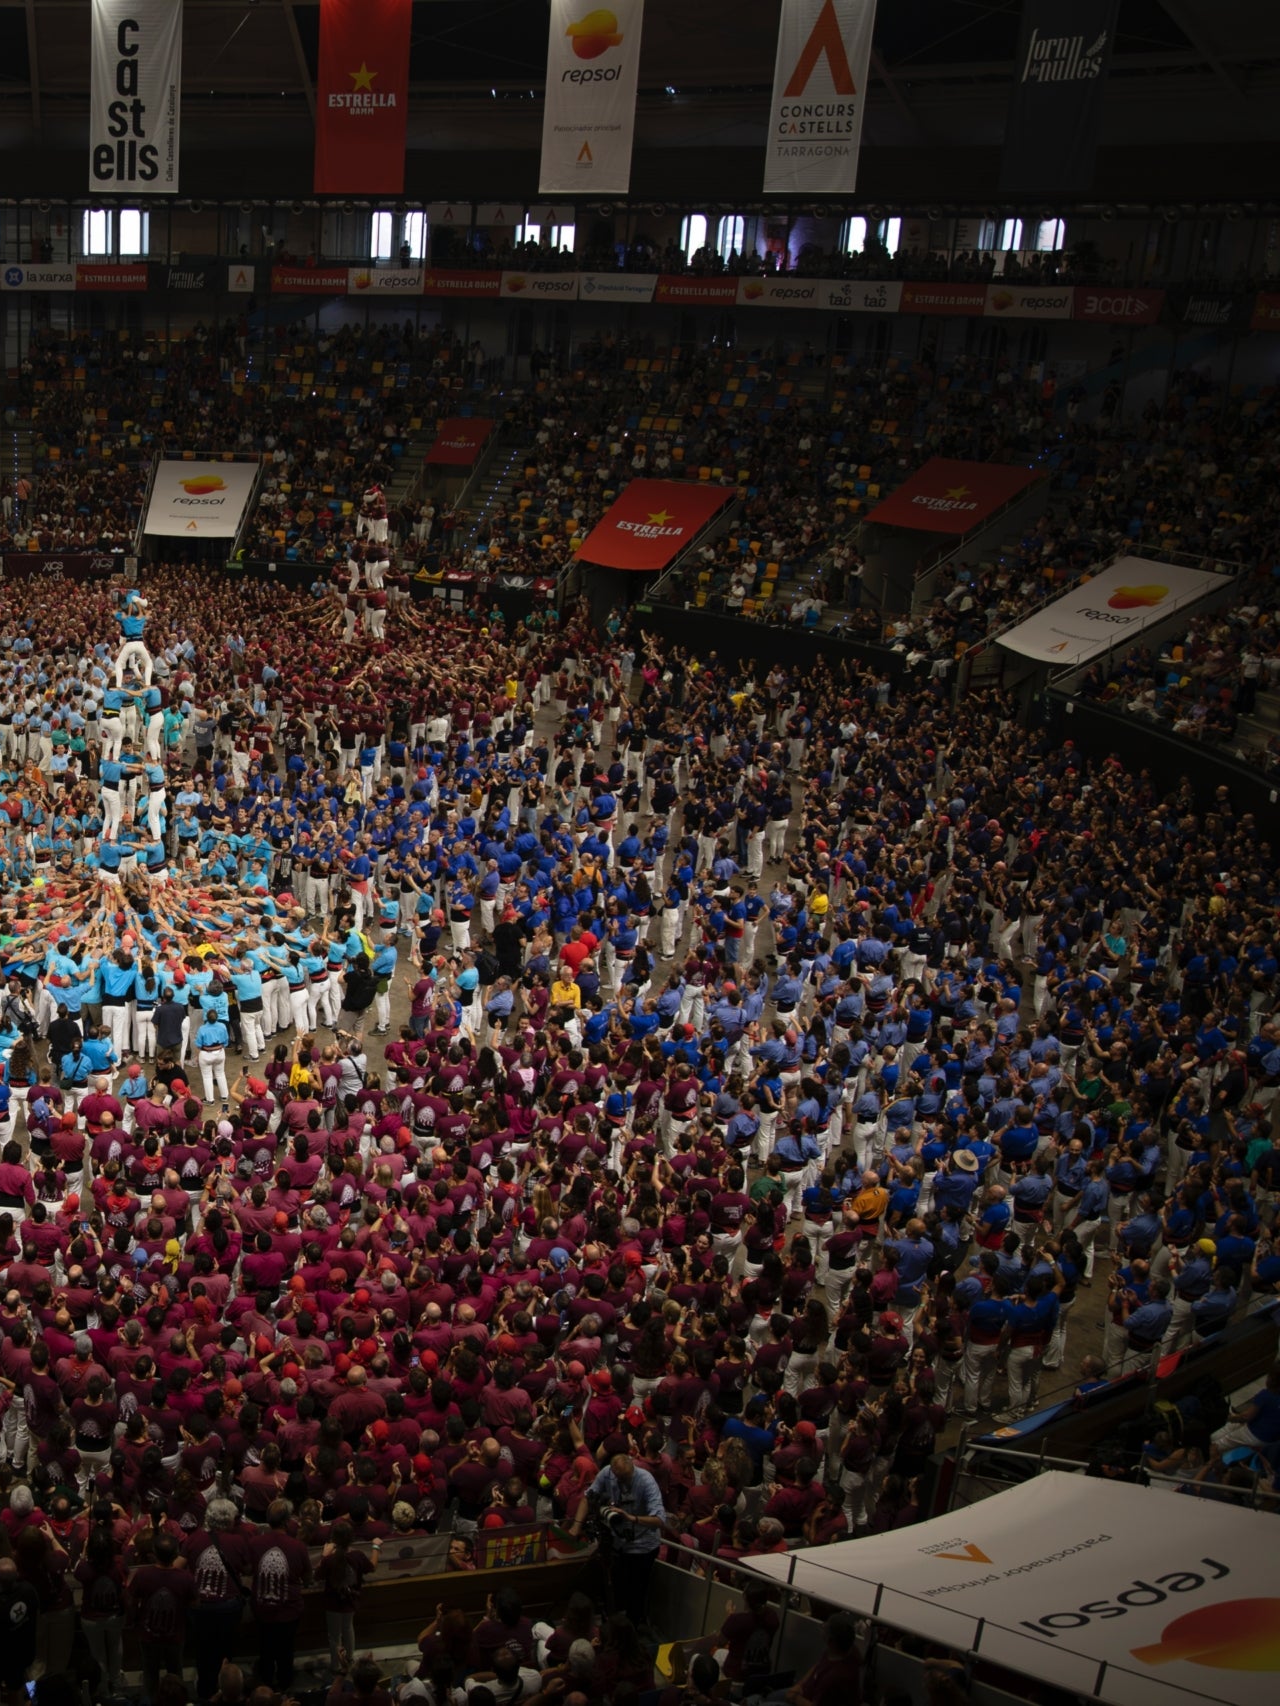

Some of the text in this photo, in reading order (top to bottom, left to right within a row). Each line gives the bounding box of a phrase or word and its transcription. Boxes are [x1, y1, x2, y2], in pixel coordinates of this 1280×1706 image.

[561, 64, 622, 86] repsol
[328, 93, 397, 108] ESTRELLA
[349, 107, 374, 116] DAMM
[780, 104, 856, 118] CONCURS
[107, 99, 145, 138] st
[778, 120, 853, 135] CASTELLS
[777, 146, 851, 157] TARRAGONA
[93, 140, 158, 181] ells
[26, 269, 73, 282] la xarxa
[84, 274, 120, 283] ESTRELLA
[284, 277, 320, 286] ESTRELLA
[378, 275, 419, 288] repsol
[532, 280, 574, 293] repsol
[669, 286, 708, 296] ESTRELLA
[770, 286, 815, 299] repsol
[1020, 296, 1068, 310] repsol
[173, 497, 226, 506] repsol
[911, 495, 978, 511] ESTRELLA
[616, 520, 683, 536] ESTRELLA
[42, 561, 63, 572] XICS
[1076, 608, 1139, 624] repsol
[920, 1533, 1113, 1598] Patrocinador principal
[1019, 1556, 1231, 1638] repsol
